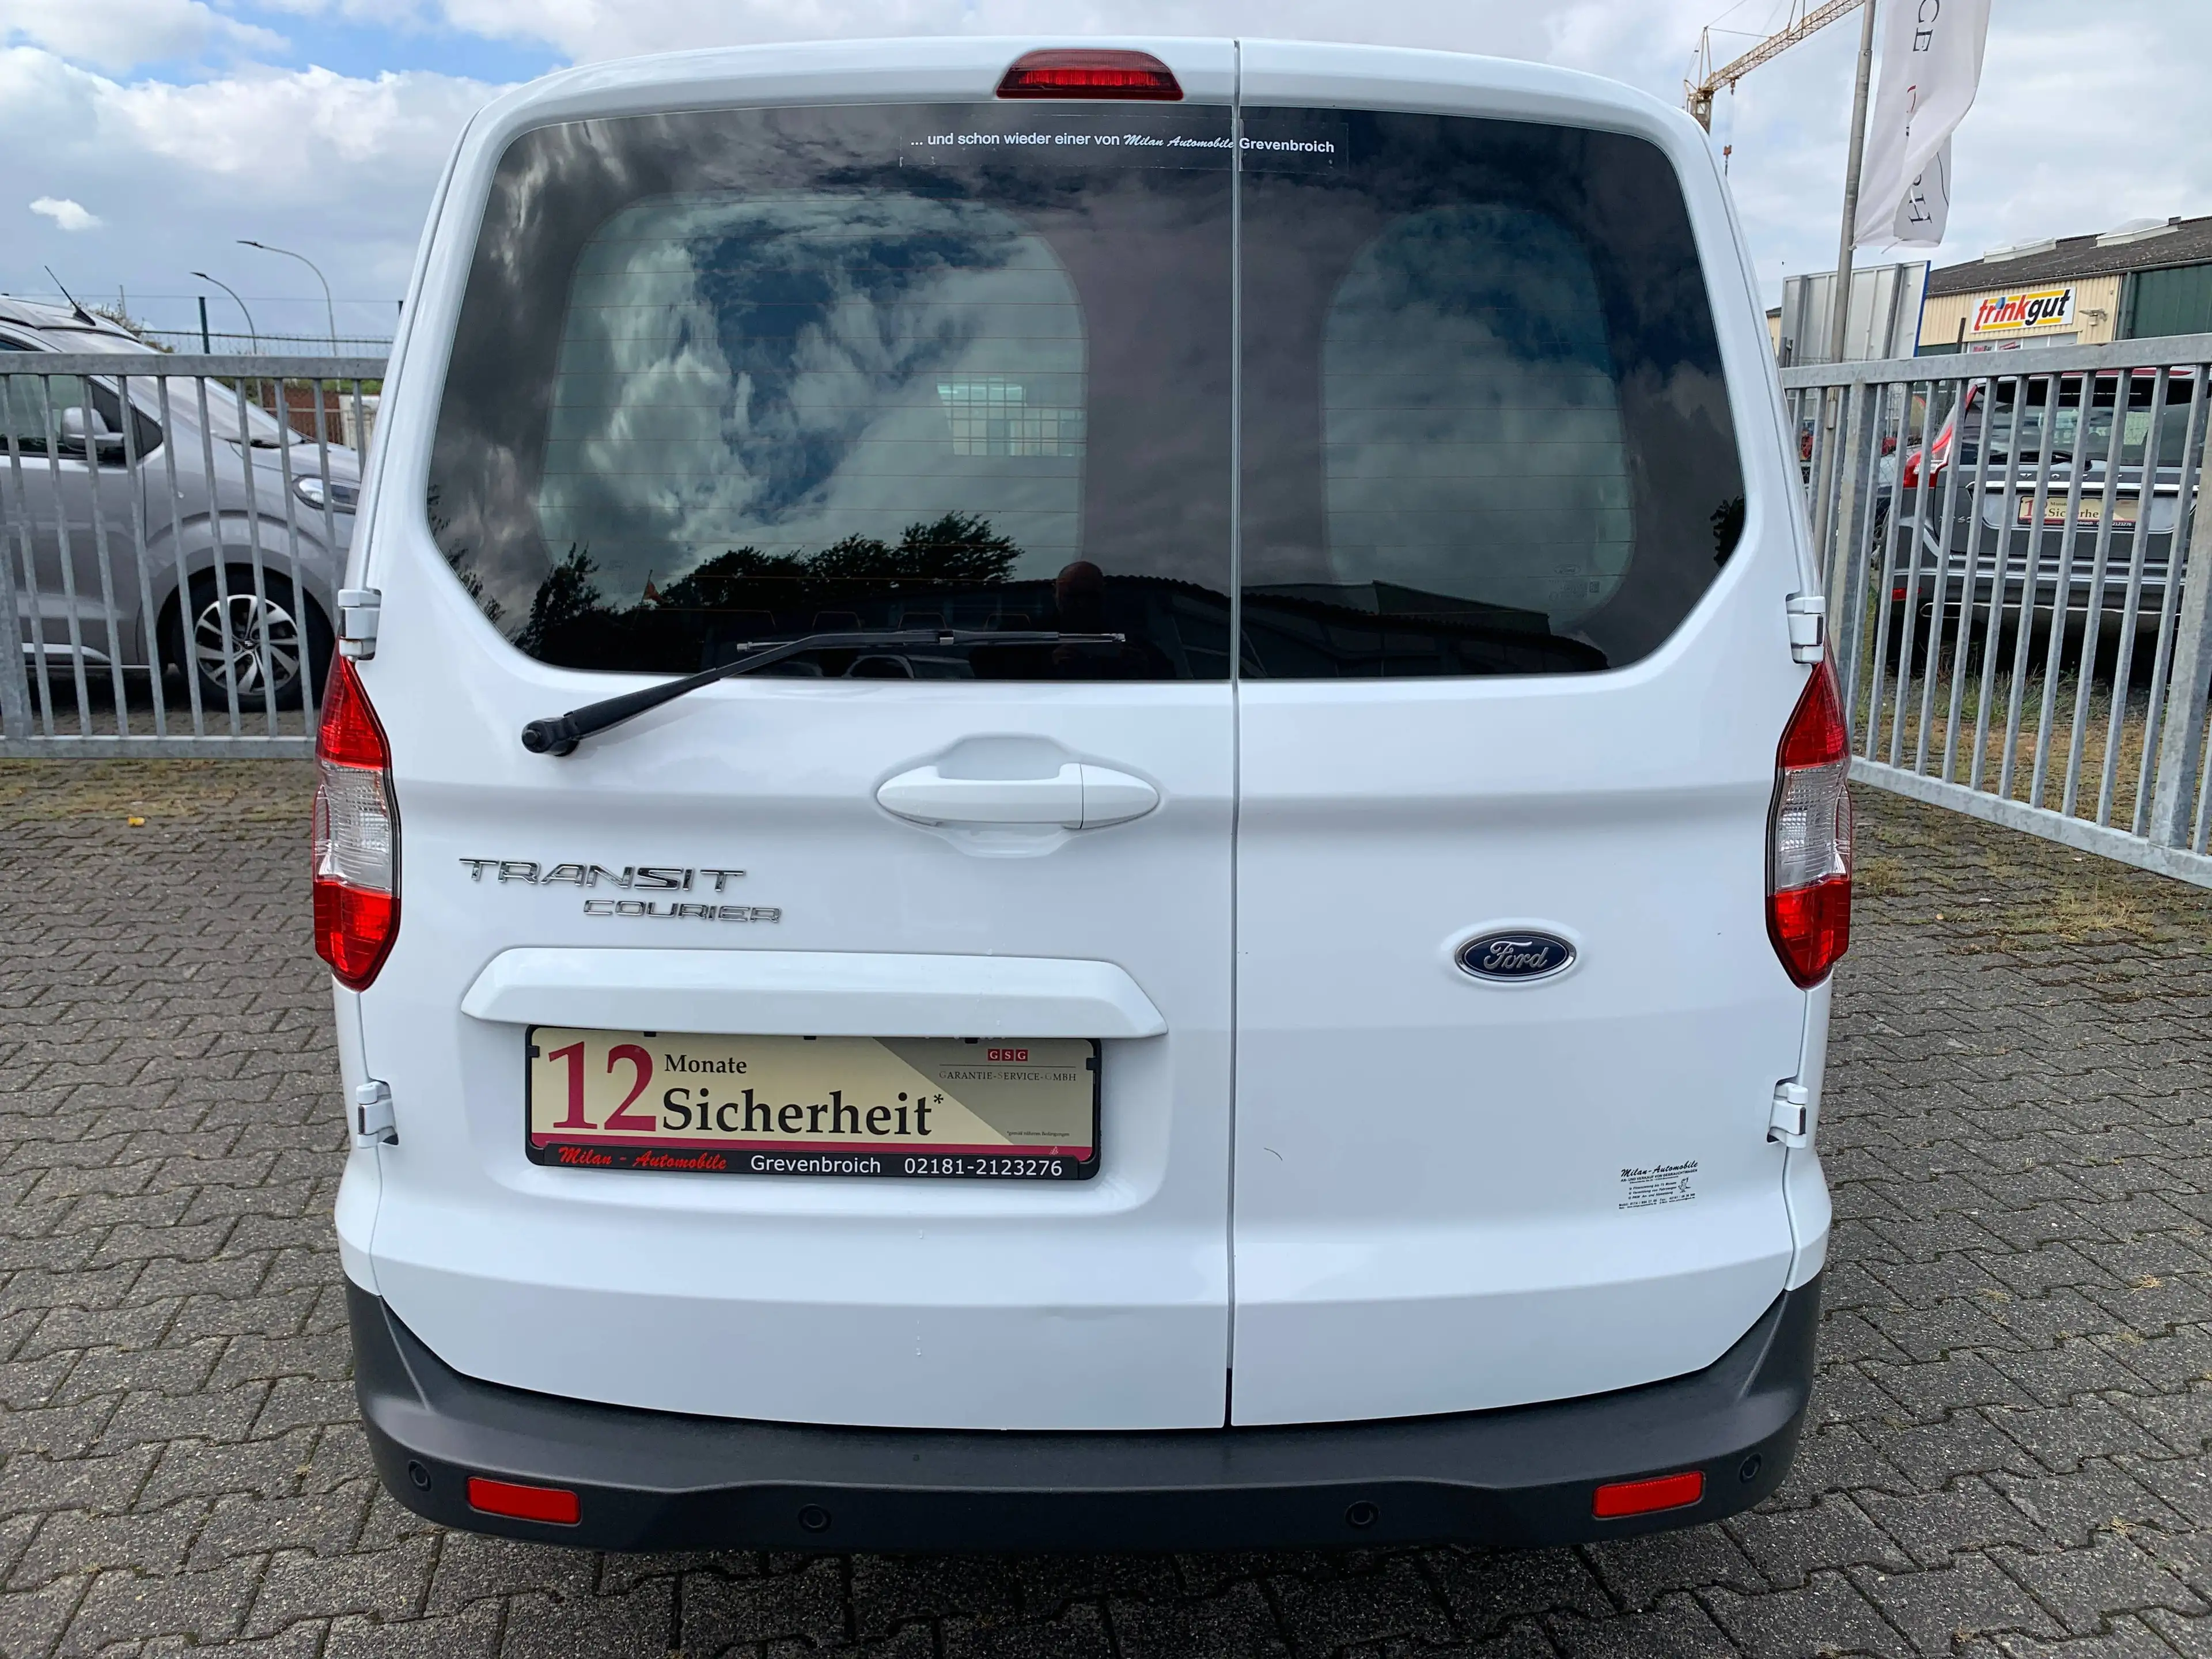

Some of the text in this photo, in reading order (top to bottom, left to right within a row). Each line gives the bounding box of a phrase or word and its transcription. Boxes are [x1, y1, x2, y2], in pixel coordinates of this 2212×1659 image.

[927, 133, 953, 145] und
[957, 133, 1000, 145] schon
[1003, 132, 1051, 145] wieder
[1055, 132, 1090, 145] einer
[1094, 135, 1120, 145] von
[1123, 134, 1164, 146] Milan
[1166, 135, 1234, 149] Automobile
[1239, 137, 1335, 153] Grevenbroich
[1974, 289, 2071, 331] trinkgut
[459, 858, 747, 892] TRANSIT
[583, 899, 782, 923] COURIER
[1483, 941, 1550, 969] Ford
[548, 1041, 747, 1131] 12 Monate
[558, 1147, 612, 1165] Milan
[632, 1150, 728, 1170] Automobile
[751, 1154, 881, 1173] Grevenbroich
[904, 1158, 1063, 1176] 02181-2123276
